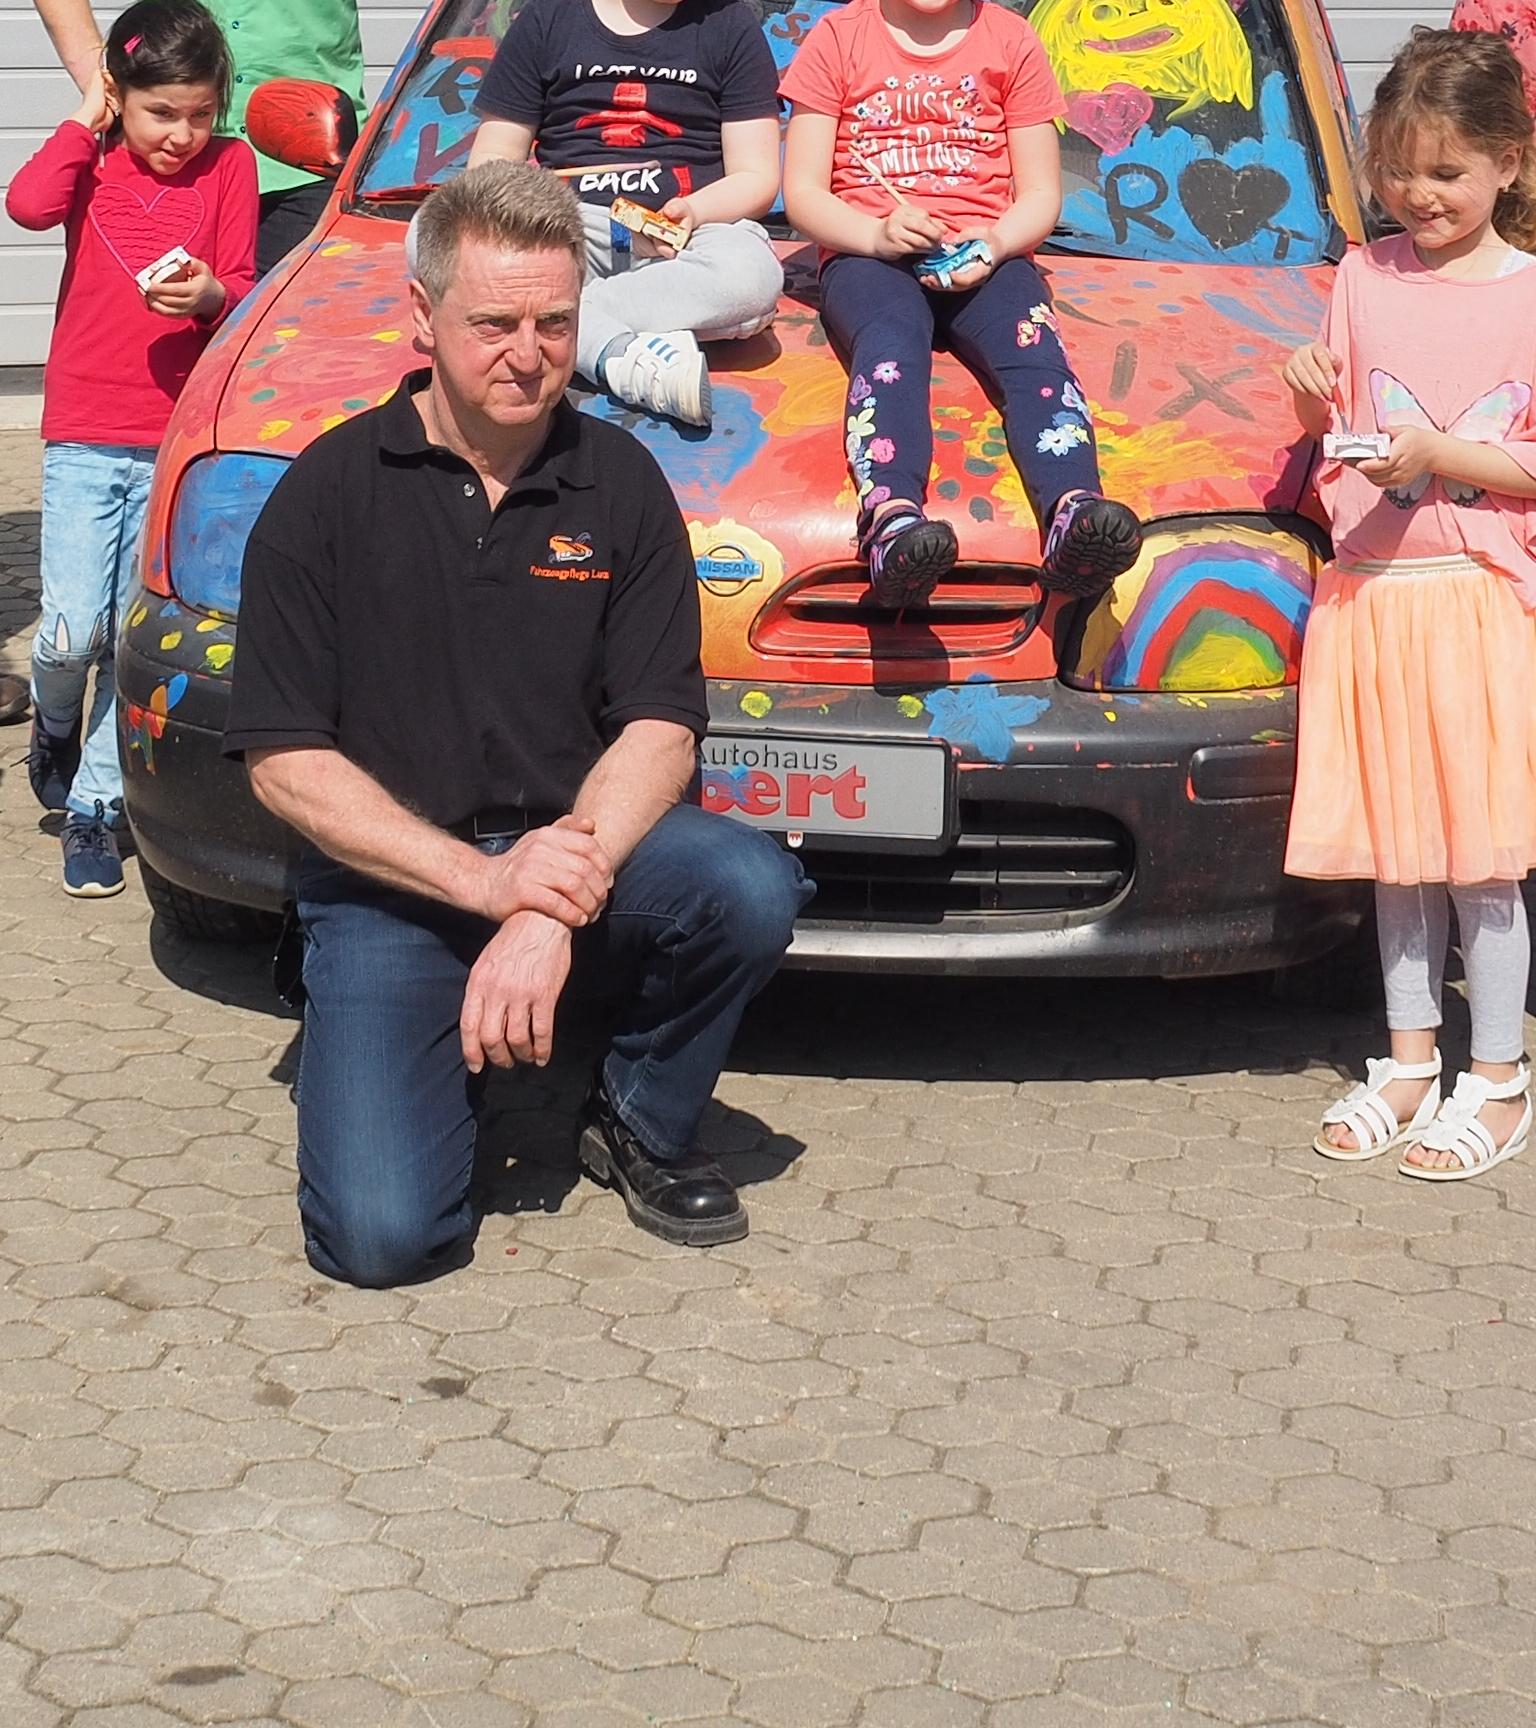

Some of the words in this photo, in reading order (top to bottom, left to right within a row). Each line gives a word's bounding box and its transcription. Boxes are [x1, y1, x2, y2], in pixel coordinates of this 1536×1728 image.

[890, 90, 953, 127] JUST
[579, 168, 663, 194] BACK
[696, 560, 756, 575] NISSAN
